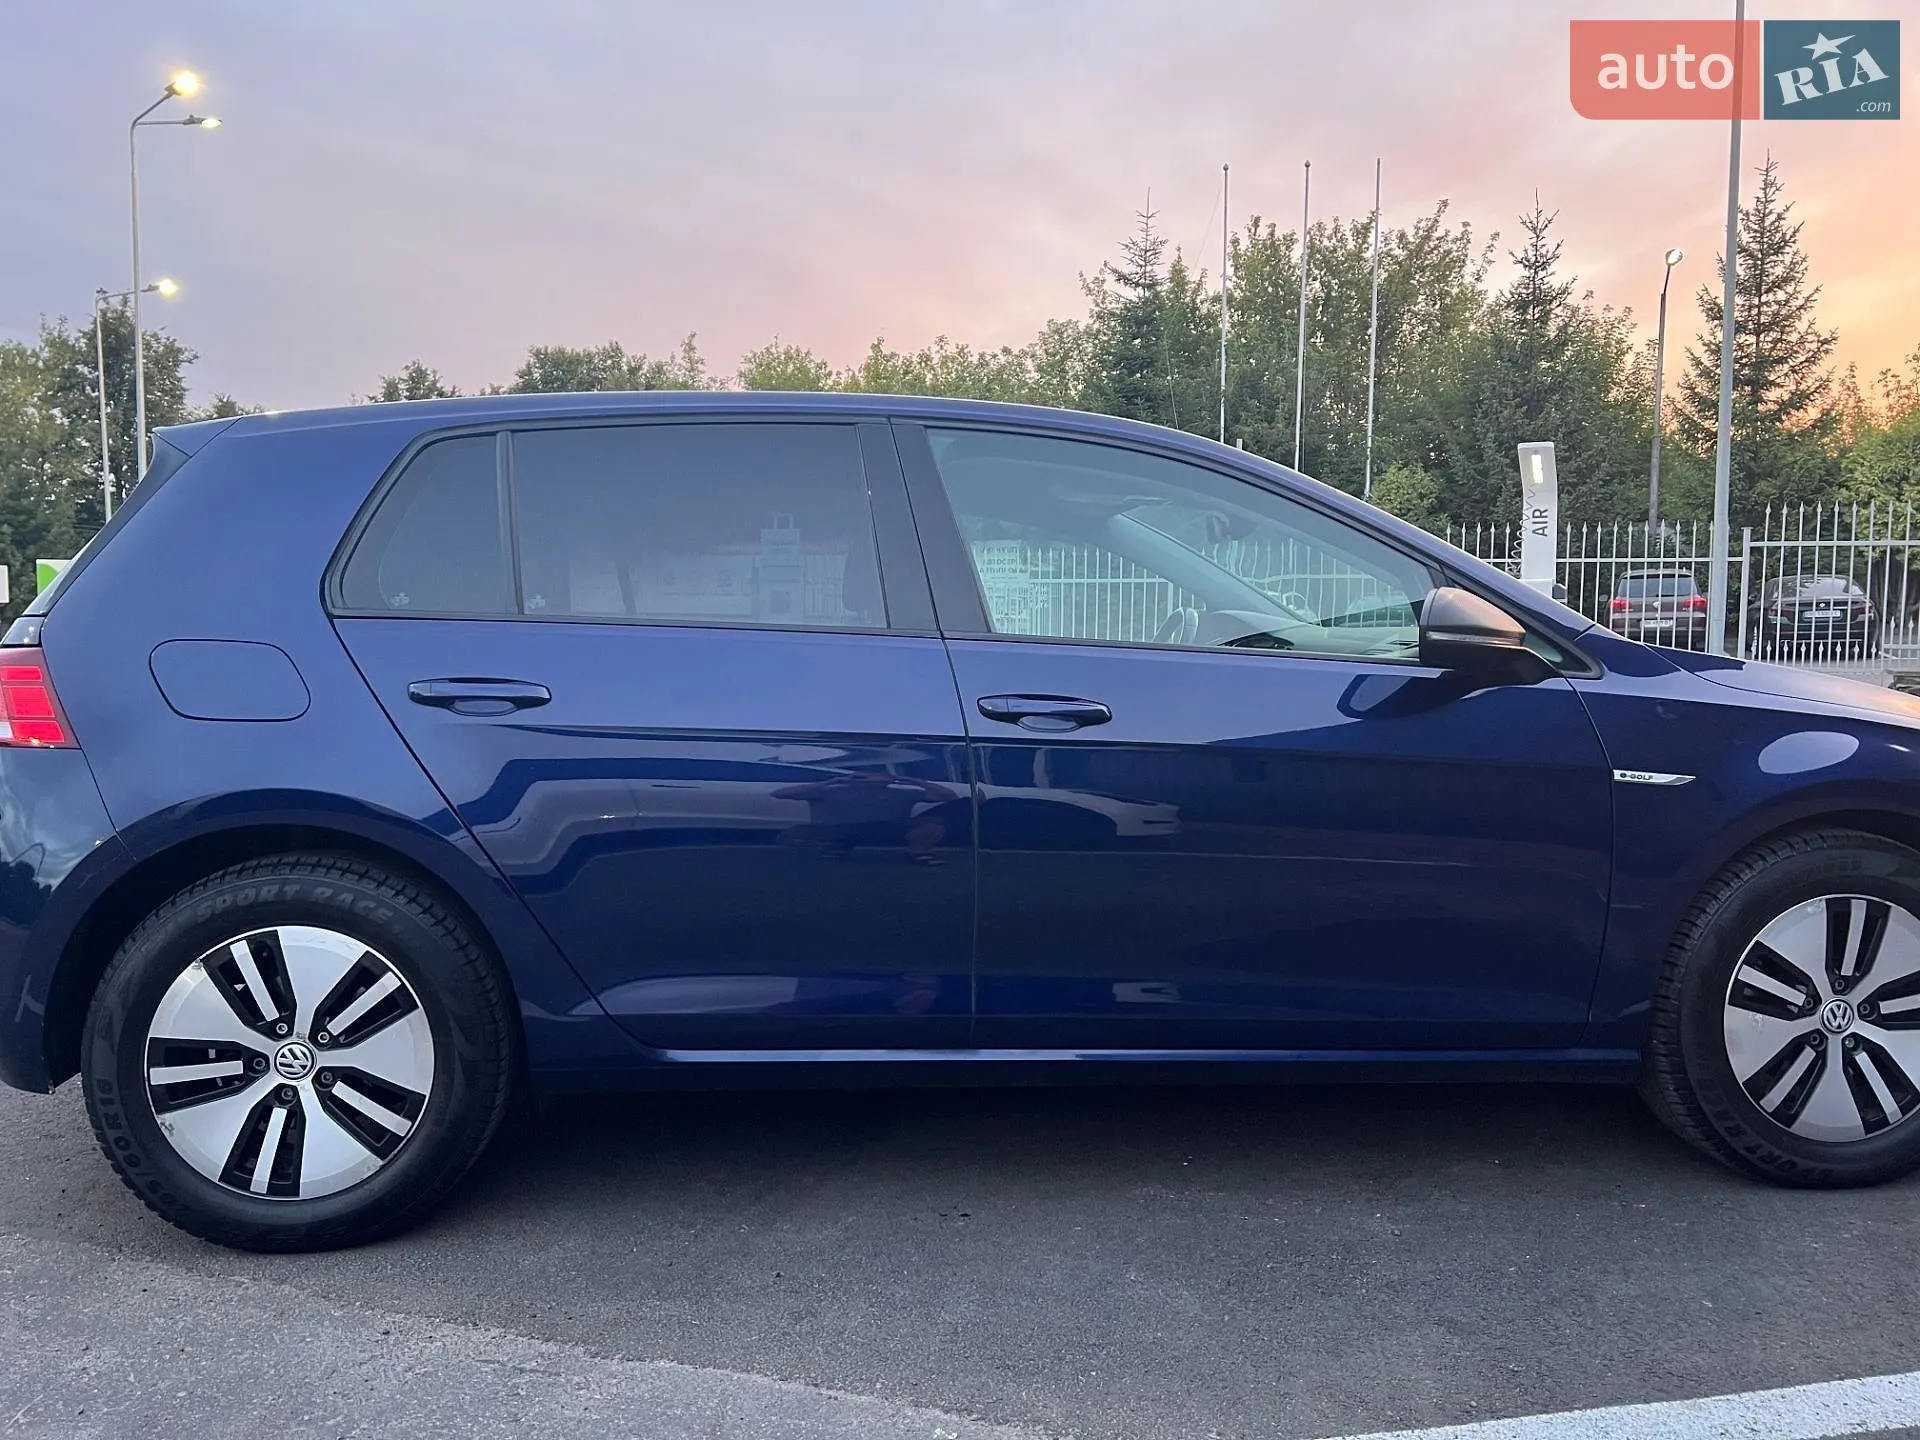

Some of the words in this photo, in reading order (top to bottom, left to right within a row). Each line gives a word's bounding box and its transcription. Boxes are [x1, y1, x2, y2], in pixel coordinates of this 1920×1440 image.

[1532, 508, 1549, 537] AIR
[195, 882, 302, 922] SPORT
[310, 884, 394, 923] RACE
